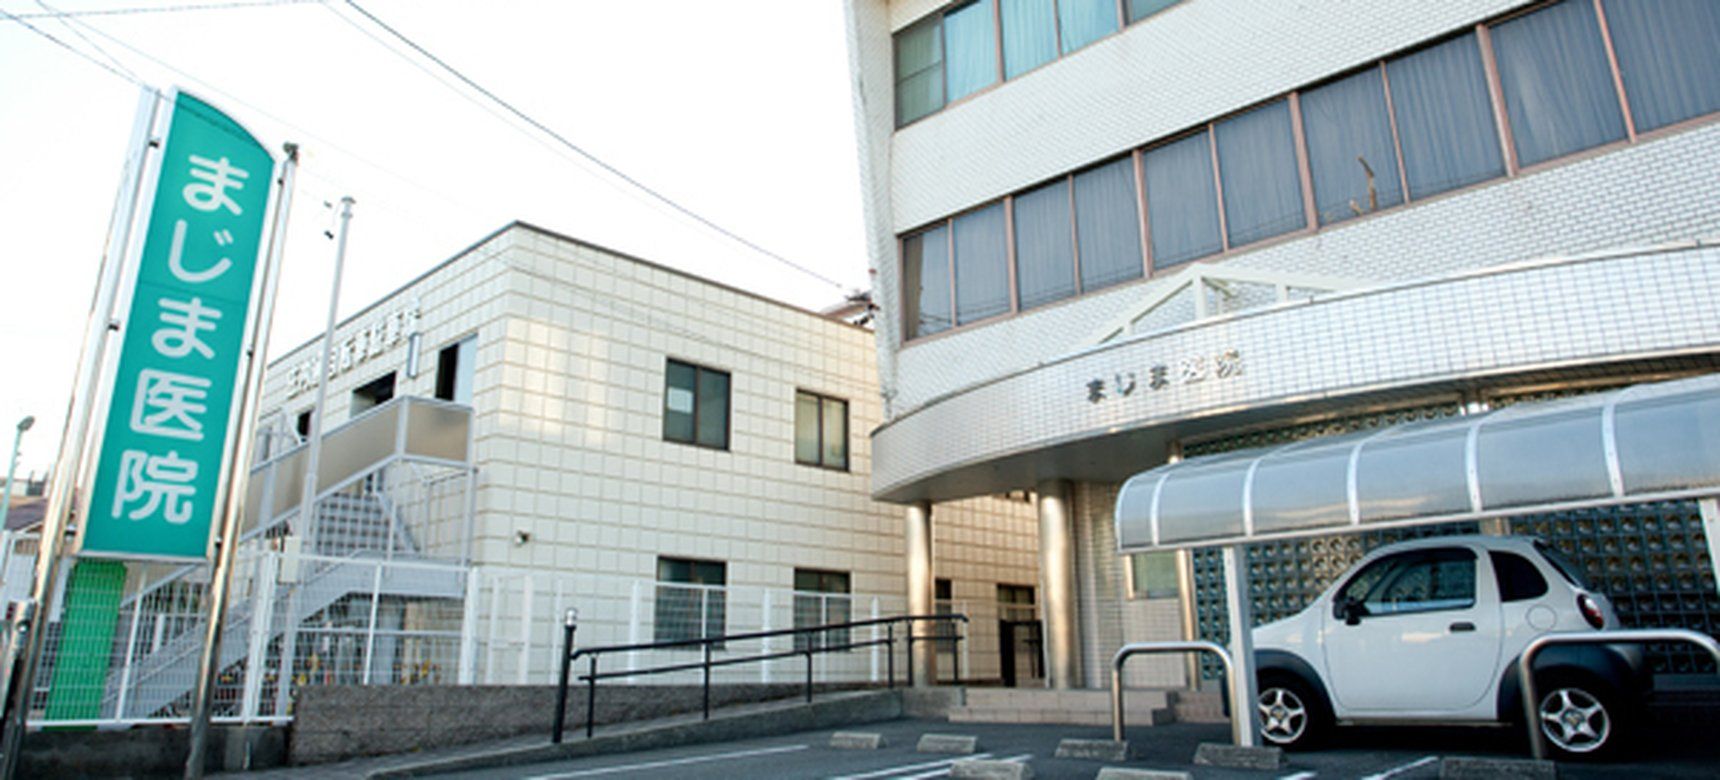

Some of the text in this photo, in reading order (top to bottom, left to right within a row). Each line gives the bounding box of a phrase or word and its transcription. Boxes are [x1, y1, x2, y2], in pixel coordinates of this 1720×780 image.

[111, 153, 249, 525] まじま医院
